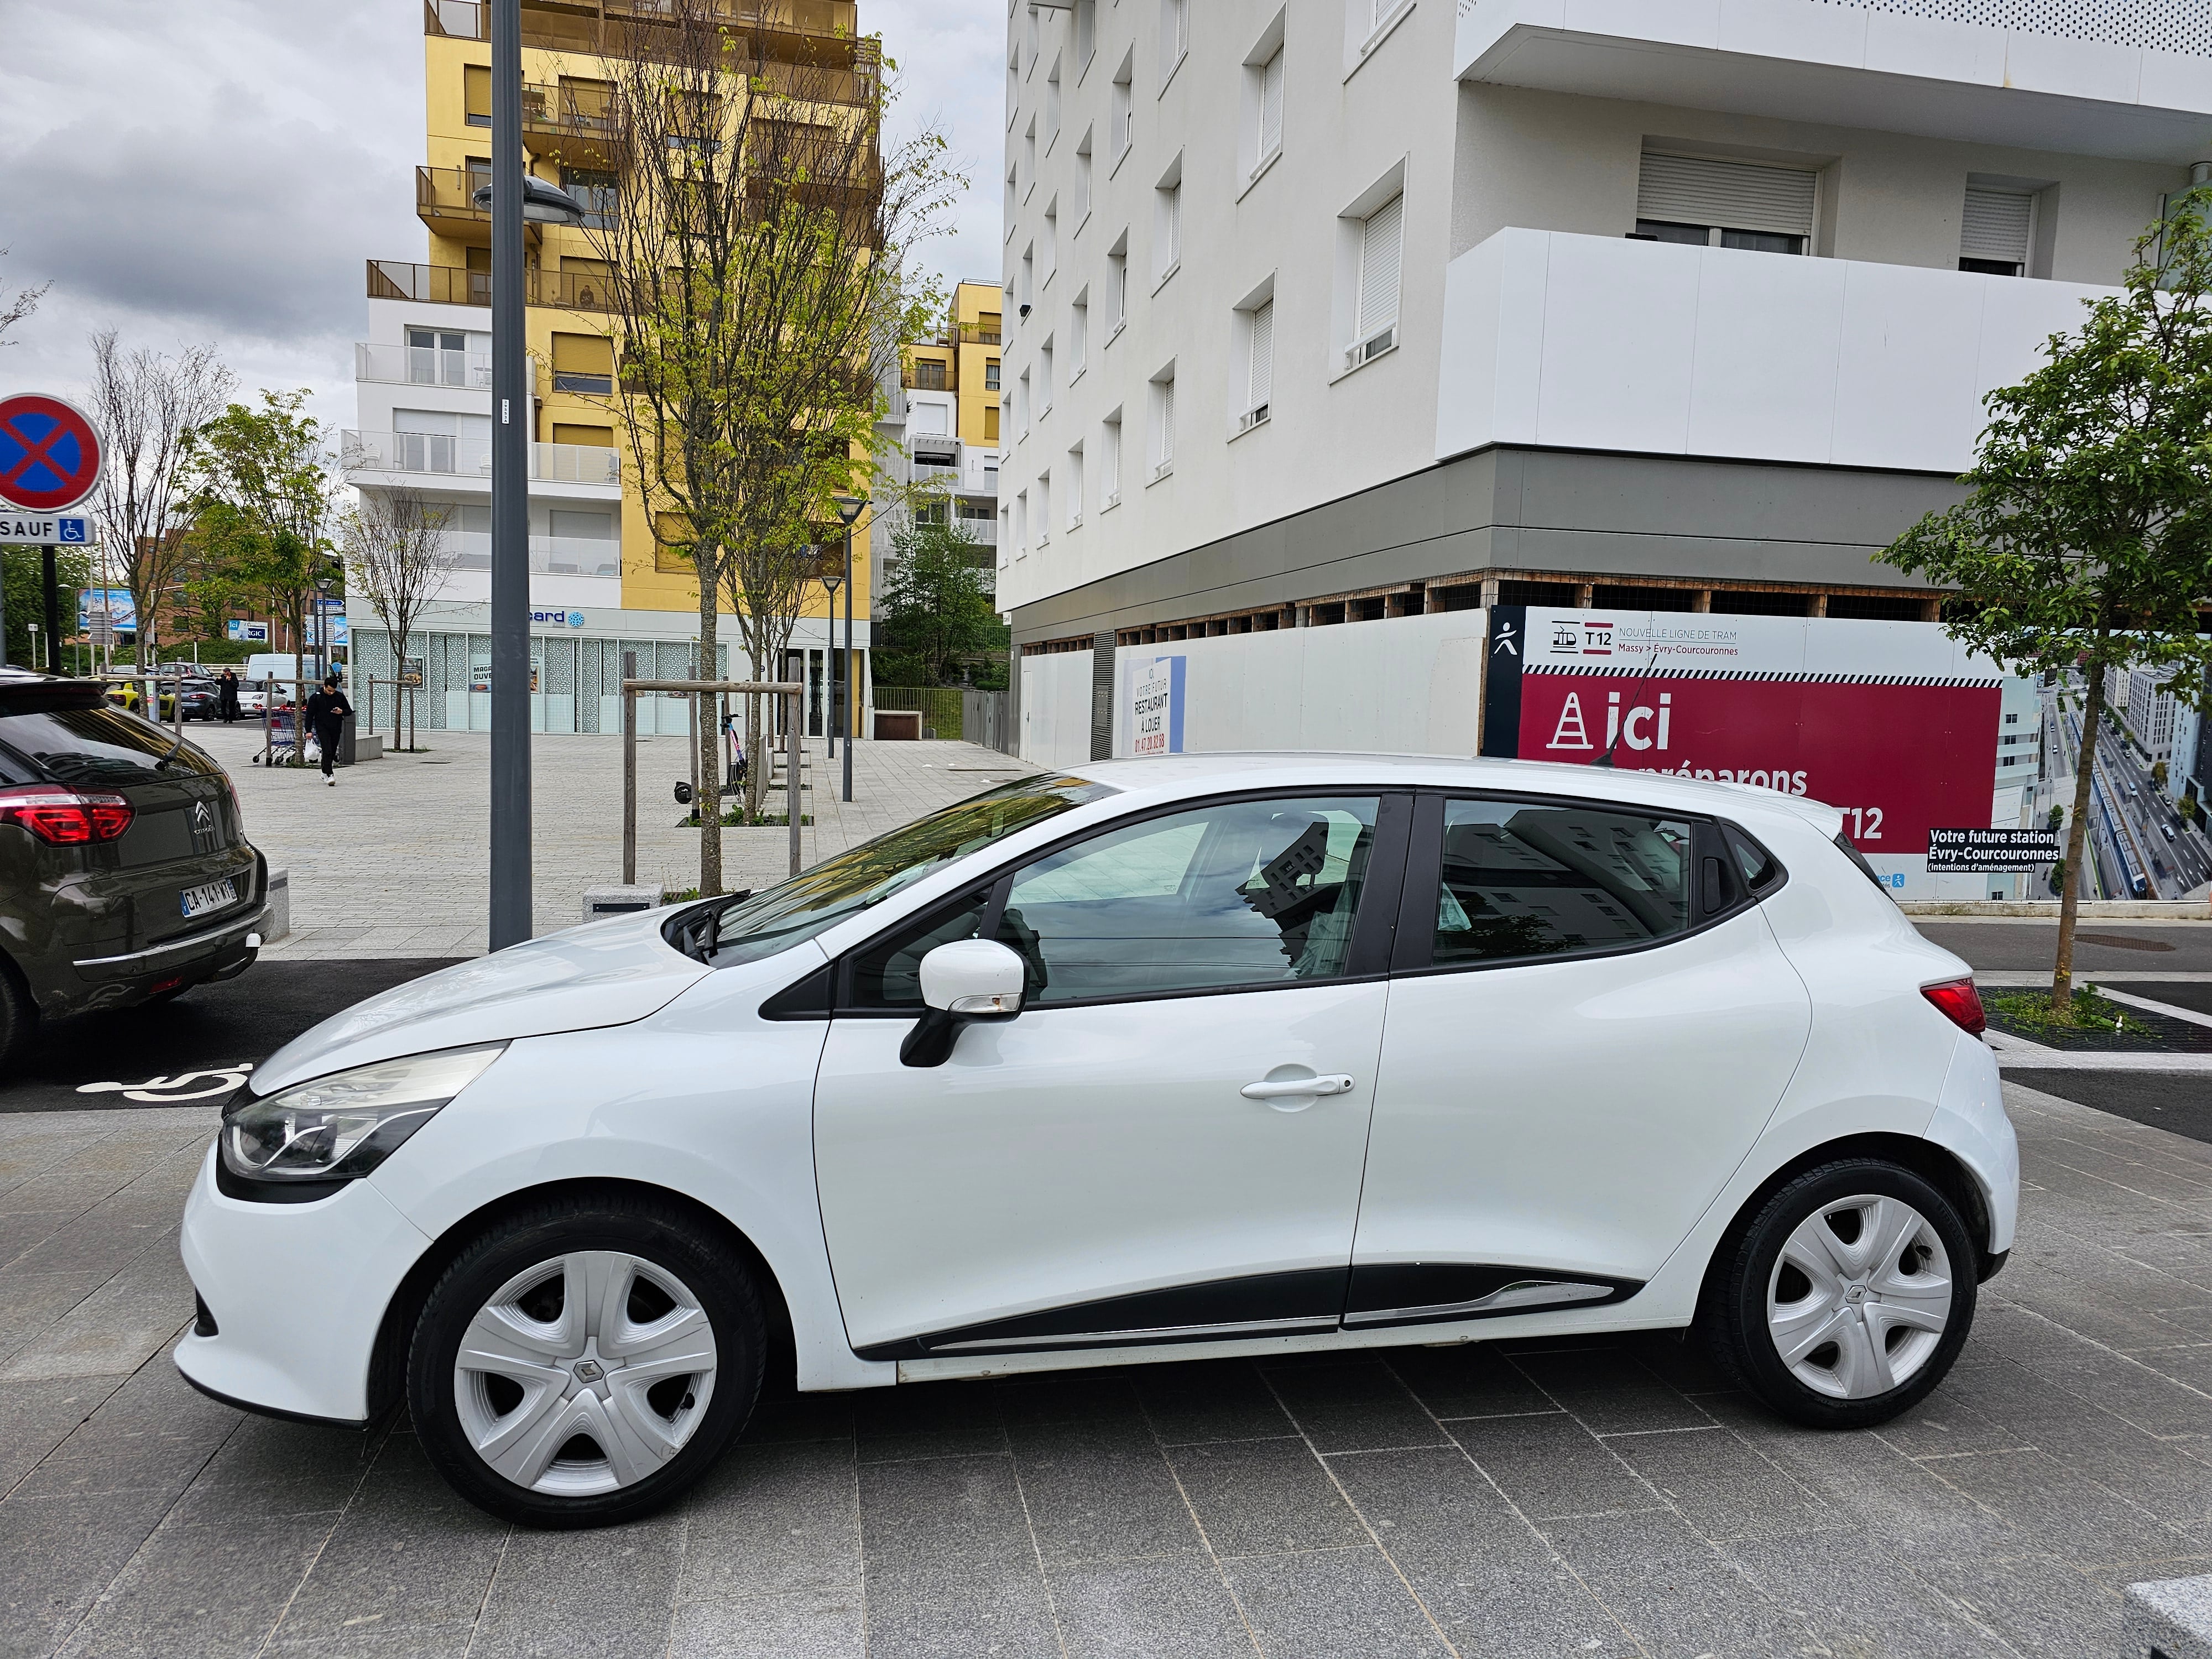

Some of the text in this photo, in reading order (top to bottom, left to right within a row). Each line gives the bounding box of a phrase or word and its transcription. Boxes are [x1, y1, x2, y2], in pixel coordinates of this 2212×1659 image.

[0, 521, 53, 537] SAUF
[1619, 628, 1736, 640] NOUVELLE LIGNE DE TRAM
[1618, 644, 1644, 653] Massy
[1653, 643, 1738, 656] Évry-Courcouronnes
[1136, 679, 1167, 697] VOTRE FUTUR
[1135, 693, 1168, 716] RESTAURANT
[1141, 716, 1160, 734] À LOUER
[1606, 692, 1671, 750] ici
[1930, 830, 2054, 844] Votre future station
[1929, 844, 2059, 862] Évry-Courcouronnes
[1928, 863, 1969, 872] (intentions
